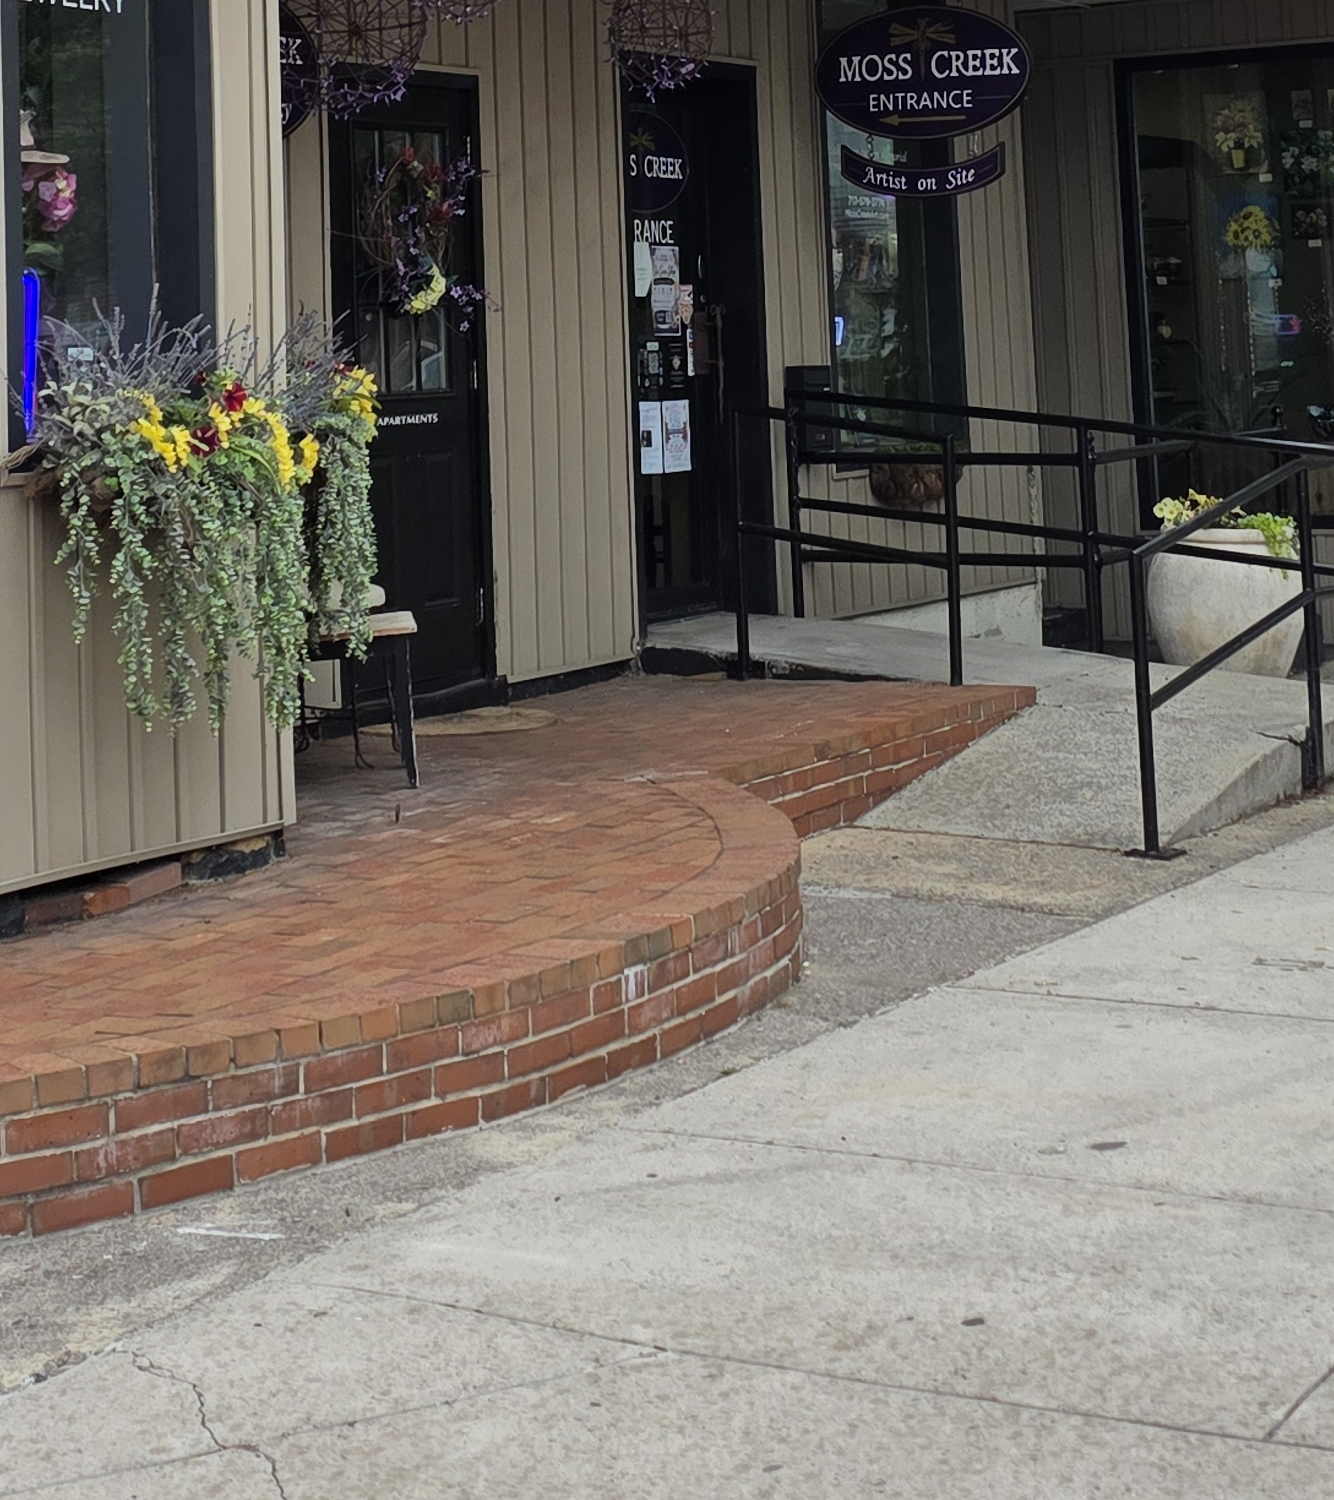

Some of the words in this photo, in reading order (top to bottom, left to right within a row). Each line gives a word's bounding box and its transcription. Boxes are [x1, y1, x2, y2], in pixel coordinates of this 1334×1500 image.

[839, 53, 913, 83] MOSS
[930, 48, 1020, 79] CREEK
[869, 89, 973, 112] ENTRANCE
[644, 155, 684, 179] CREEK
[862, 166, 908, 190] Artist
[917, 177, 937, 191] on
[945, 167, 975, 190] Site
[633, 219, 675, 244] RANCE
[376, 412, 439, 427] APARTMENTS
